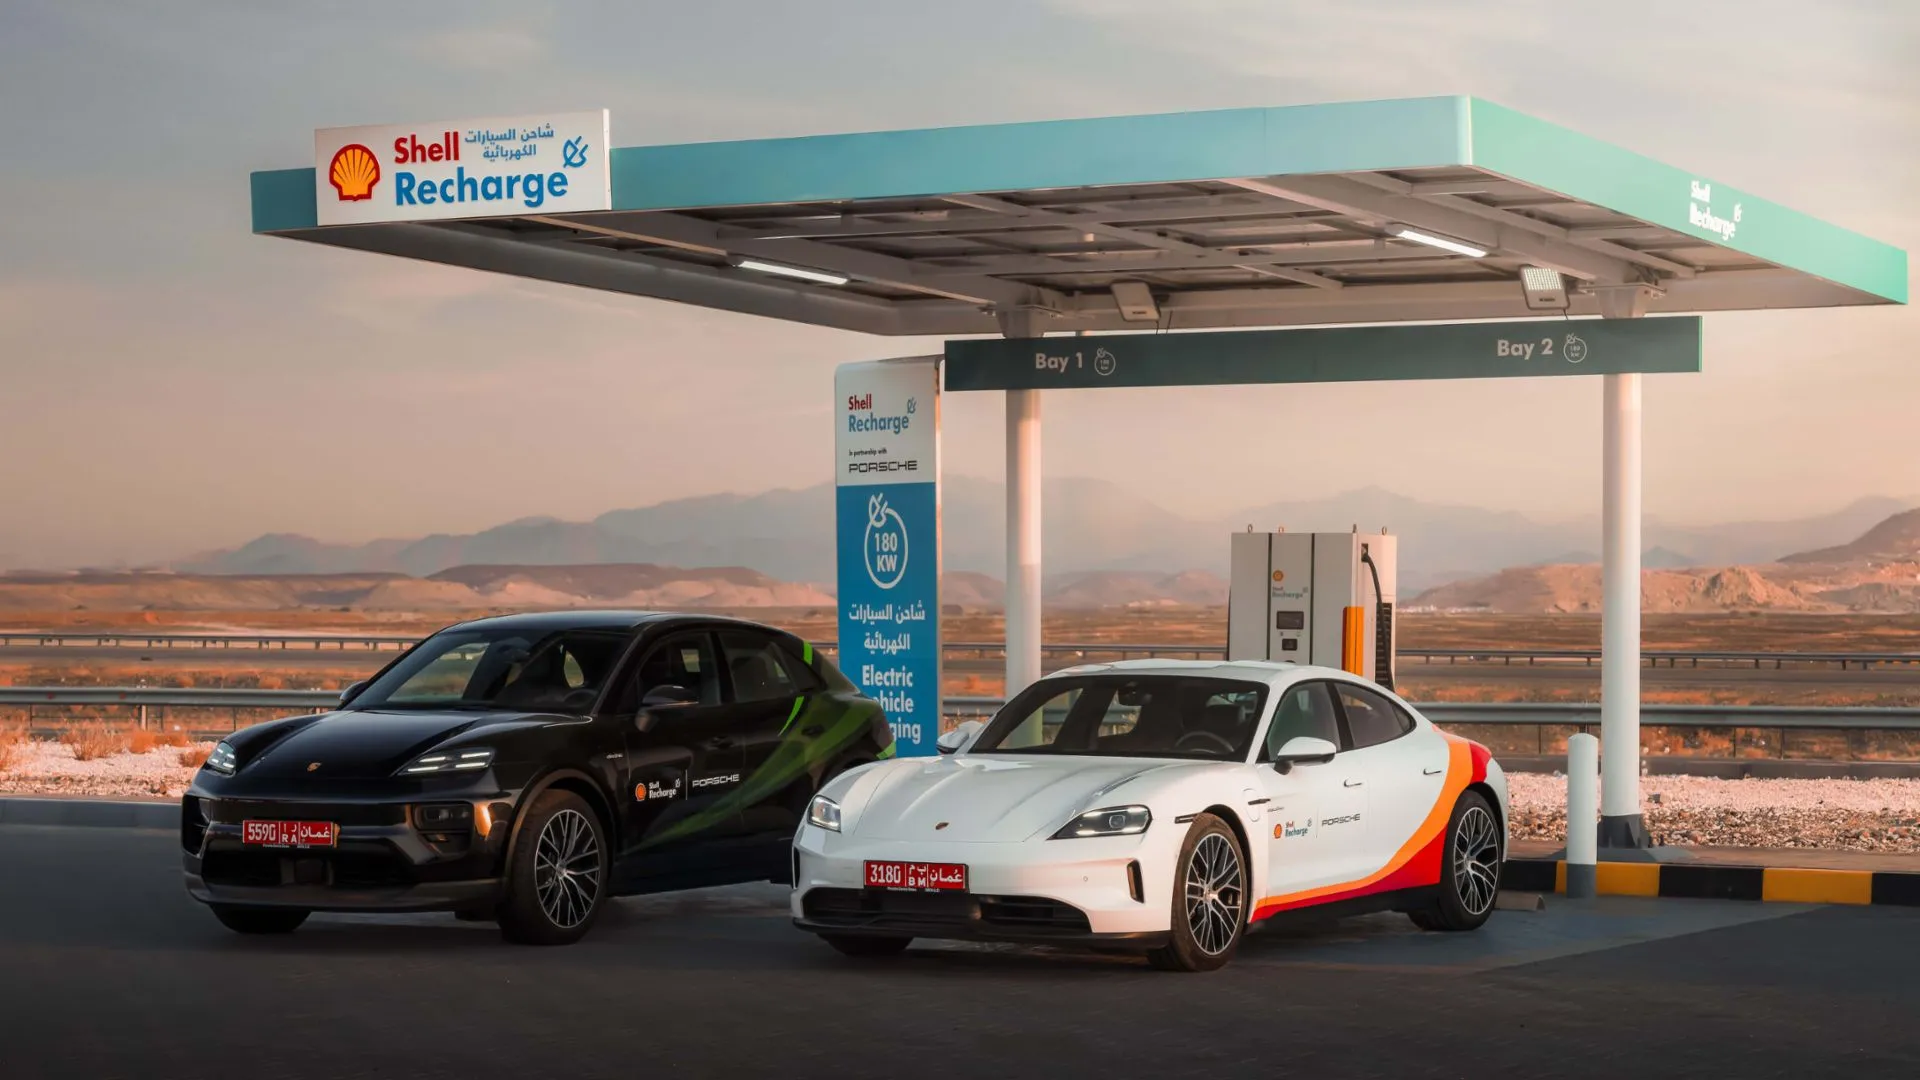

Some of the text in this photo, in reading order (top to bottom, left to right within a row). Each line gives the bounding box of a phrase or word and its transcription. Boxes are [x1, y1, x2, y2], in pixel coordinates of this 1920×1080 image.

[464, 122, 554, 146] شاحن السيارات
[394, 131, 460, 164] Shell
[483, 143, 537, 163] الكهربائية
[395, 166, 569, 208] Recharge
[1689, 201, 1736, 241] Recharge
[1497, 337, 1553, 360] Bay 2
[1035, 352, 1070, 373] Bay
[1075, 351, 1083, 369] 1
[848, 393, 872, 411] Shell
[848, 412, 909, 435] Recharge
[848, 460, 918, 473] PORSCHE
[874, 532, 898, 553] 180
[876, 554, 898, 573] KW
[848, 599, 926, 626] شاحن السيارات
[863, 630, 911, 656] الكهربائية
[862, 663, 914, 687] Electric
[872, 690, 914, 713] hicle
[692, 773, 740, 788] PORSCHE
[649, 787, 677, 799] Recharge
[1321, 813, 1361, 827] PORSCHE
[248, 823, 276, 841] 5590
[870, 864, 901, 884] 3180
